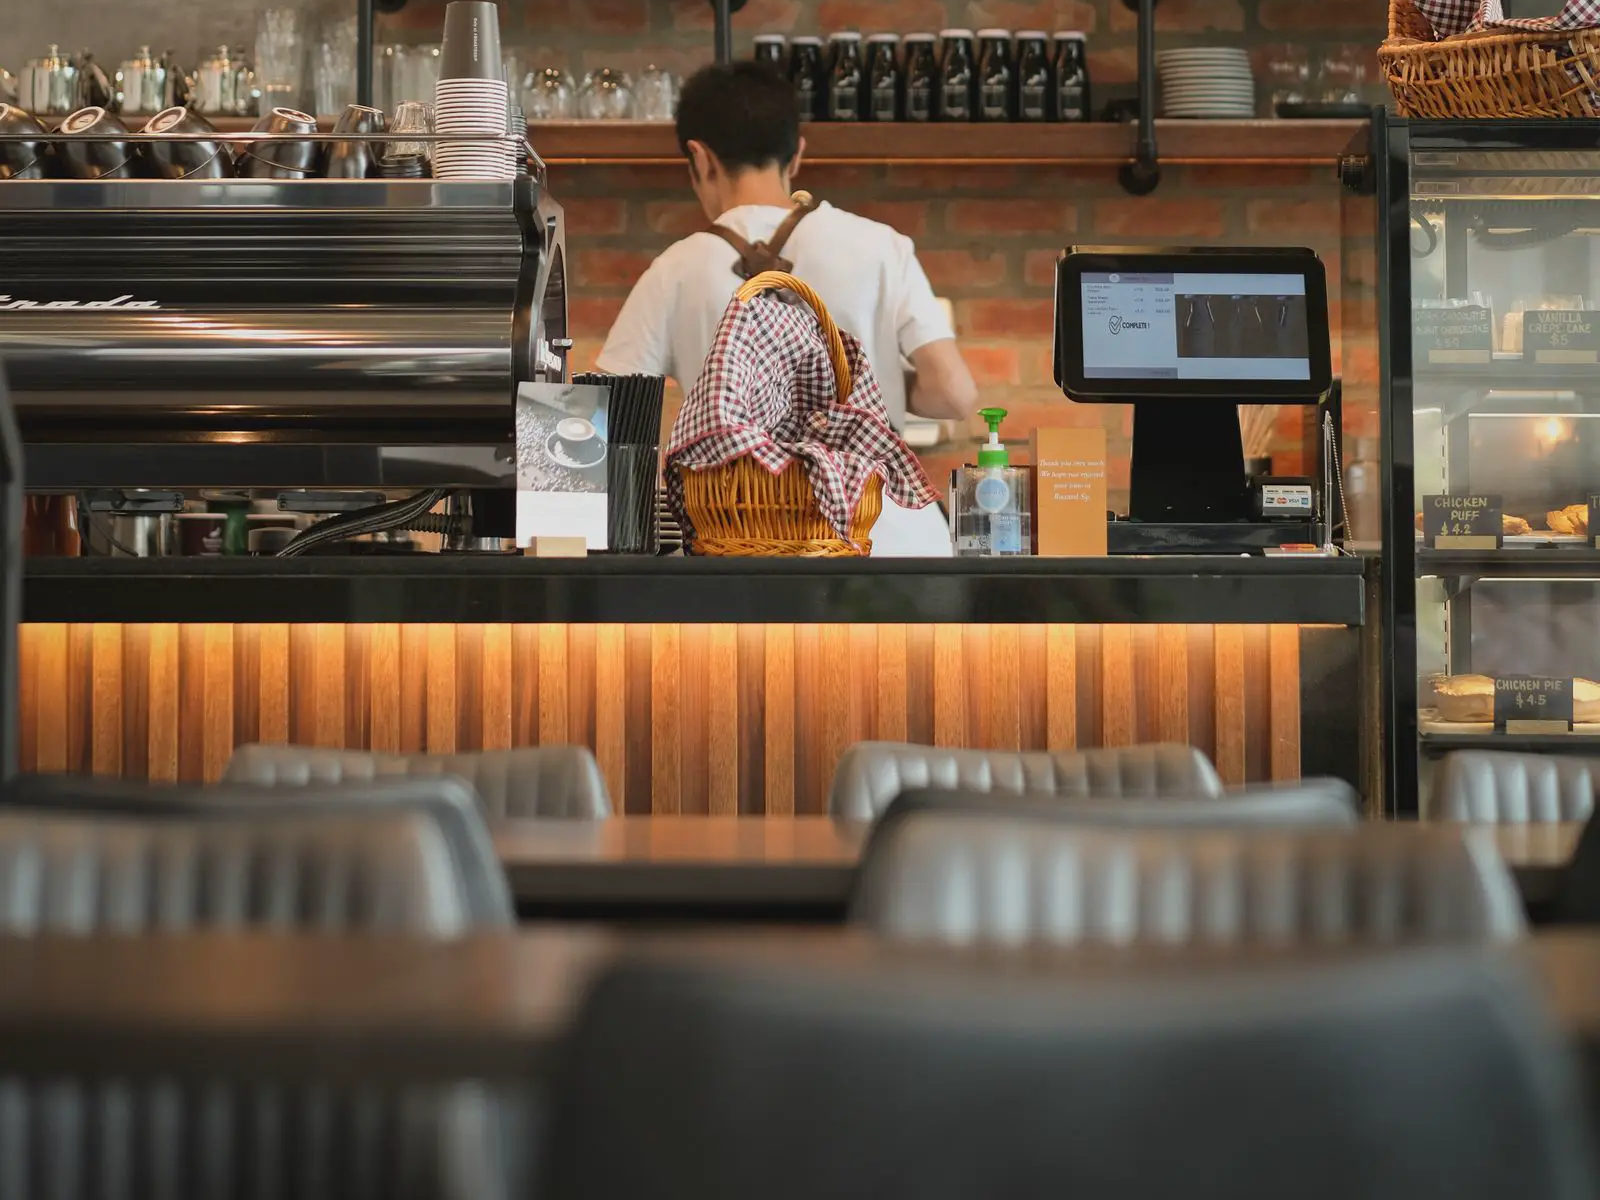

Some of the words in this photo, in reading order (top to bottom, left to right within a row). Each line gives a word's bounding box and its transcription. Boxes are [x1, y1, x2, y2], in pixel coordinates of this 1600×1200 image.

[1537, 312, 1583, 323] VANILLA
[1566, 323, 1592, 333] CAKE
[1040, 459, 1059, 467] Thank
[1052, 471, 1066, 479] hope
[1081, 471, 1104, 479] enjoyed
[1434, 497, 1488, 507] CHICKEN
[1450, 510, 1480, 521] PUFF
[1496, 680, 1540, 690] CHICKEN
[1544, 680, 1563, 690] PIE
